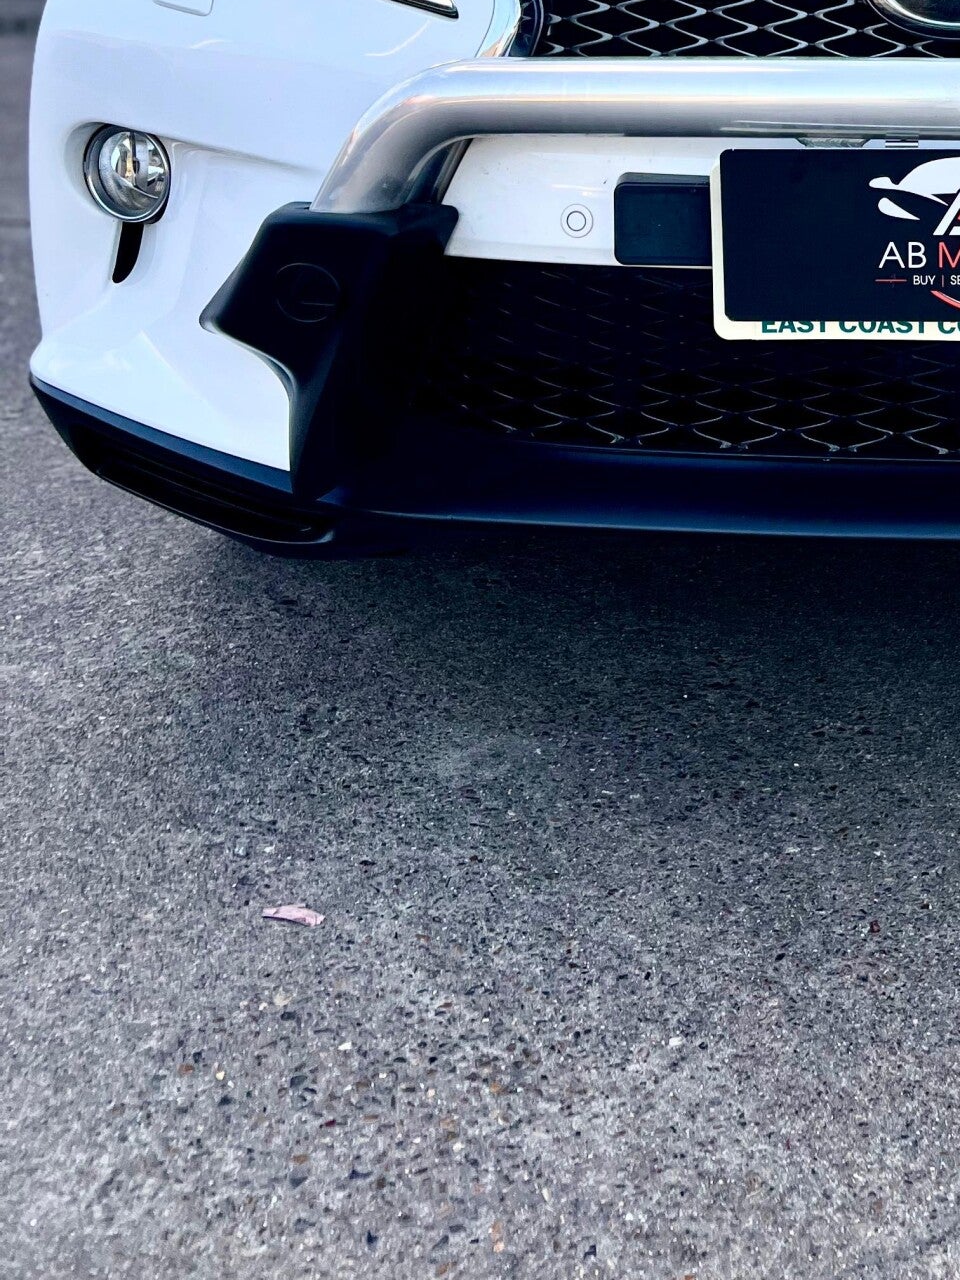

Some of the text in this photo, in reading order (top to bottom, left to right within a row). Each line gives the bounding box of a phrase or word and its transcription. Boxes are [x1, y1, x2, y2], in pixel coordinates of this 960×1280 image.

[878, 241, 927, 269] AB
[913, 275, 936, 287] BUY
[761, 320, 826, 334] EAST
[838, 320, 925, 334] COAST
